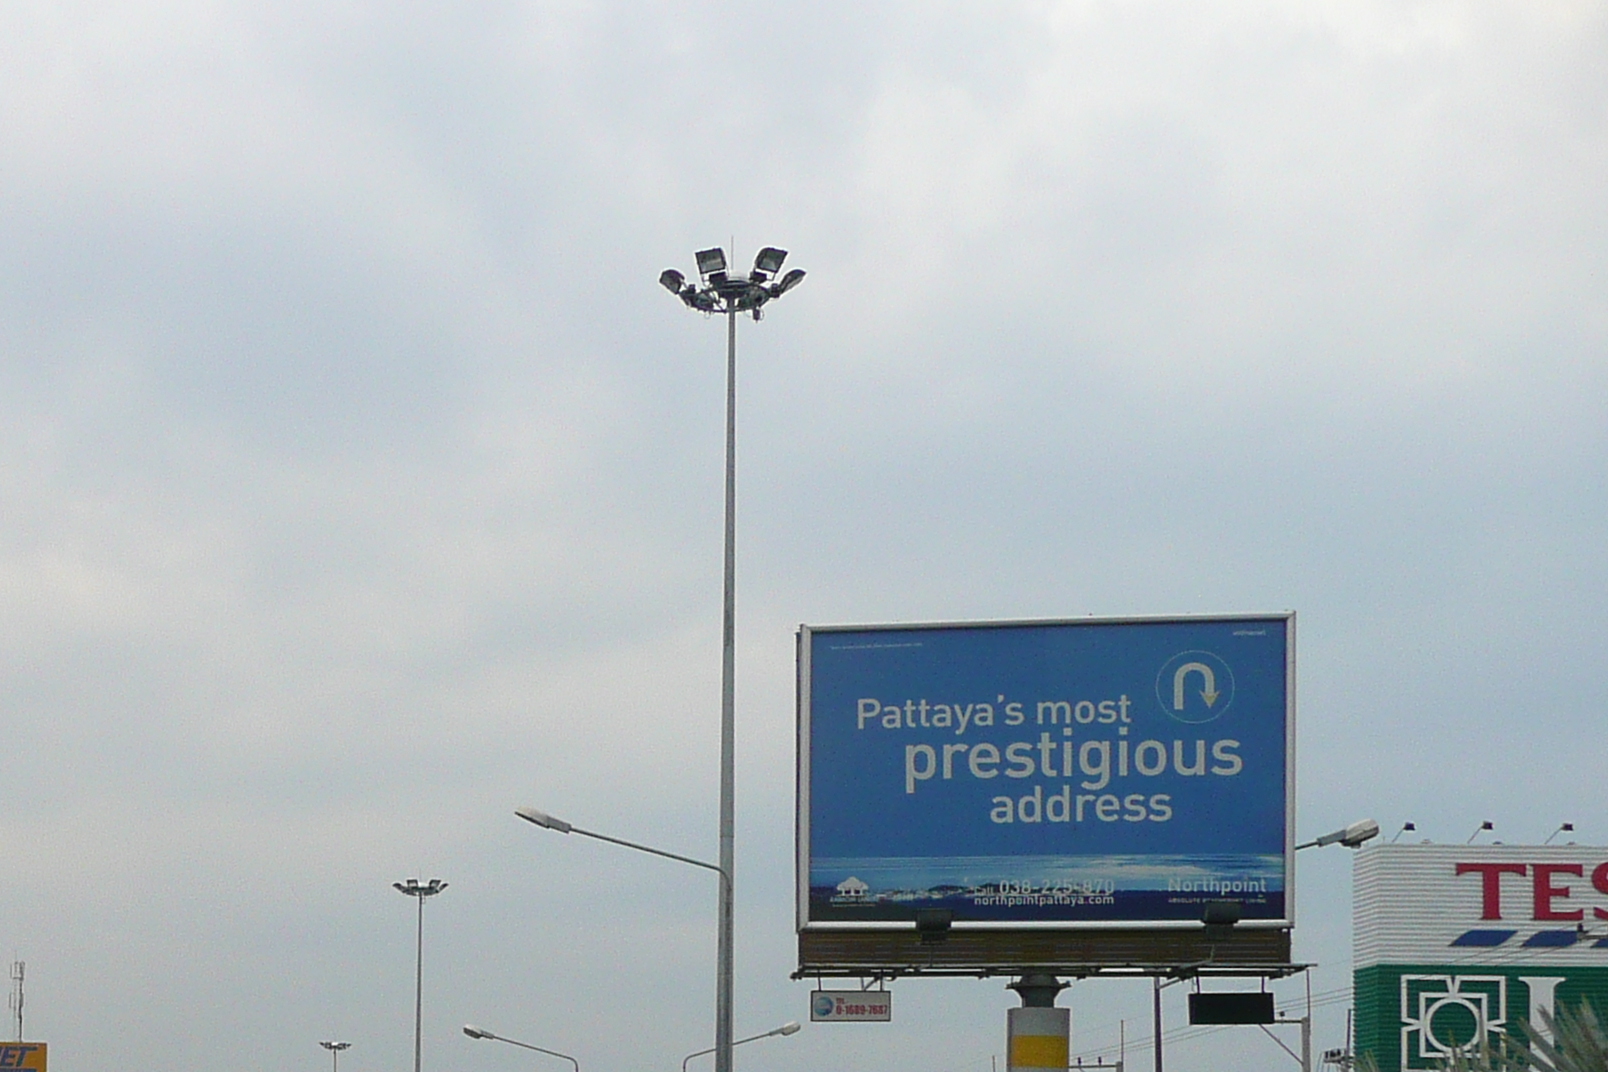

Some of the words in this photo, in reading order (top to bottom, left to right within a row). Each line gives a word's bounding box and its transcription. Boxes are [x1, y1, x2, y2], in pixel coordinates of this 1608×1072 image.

[856, 694, 1025, 735] Pattaya's
[1036, 695, 1132, 724] most
[905, 727, 1243, 794] prestigious
[990, 784, 1173, 823] address
[1168, 876, 1267, 896] Northpoint
